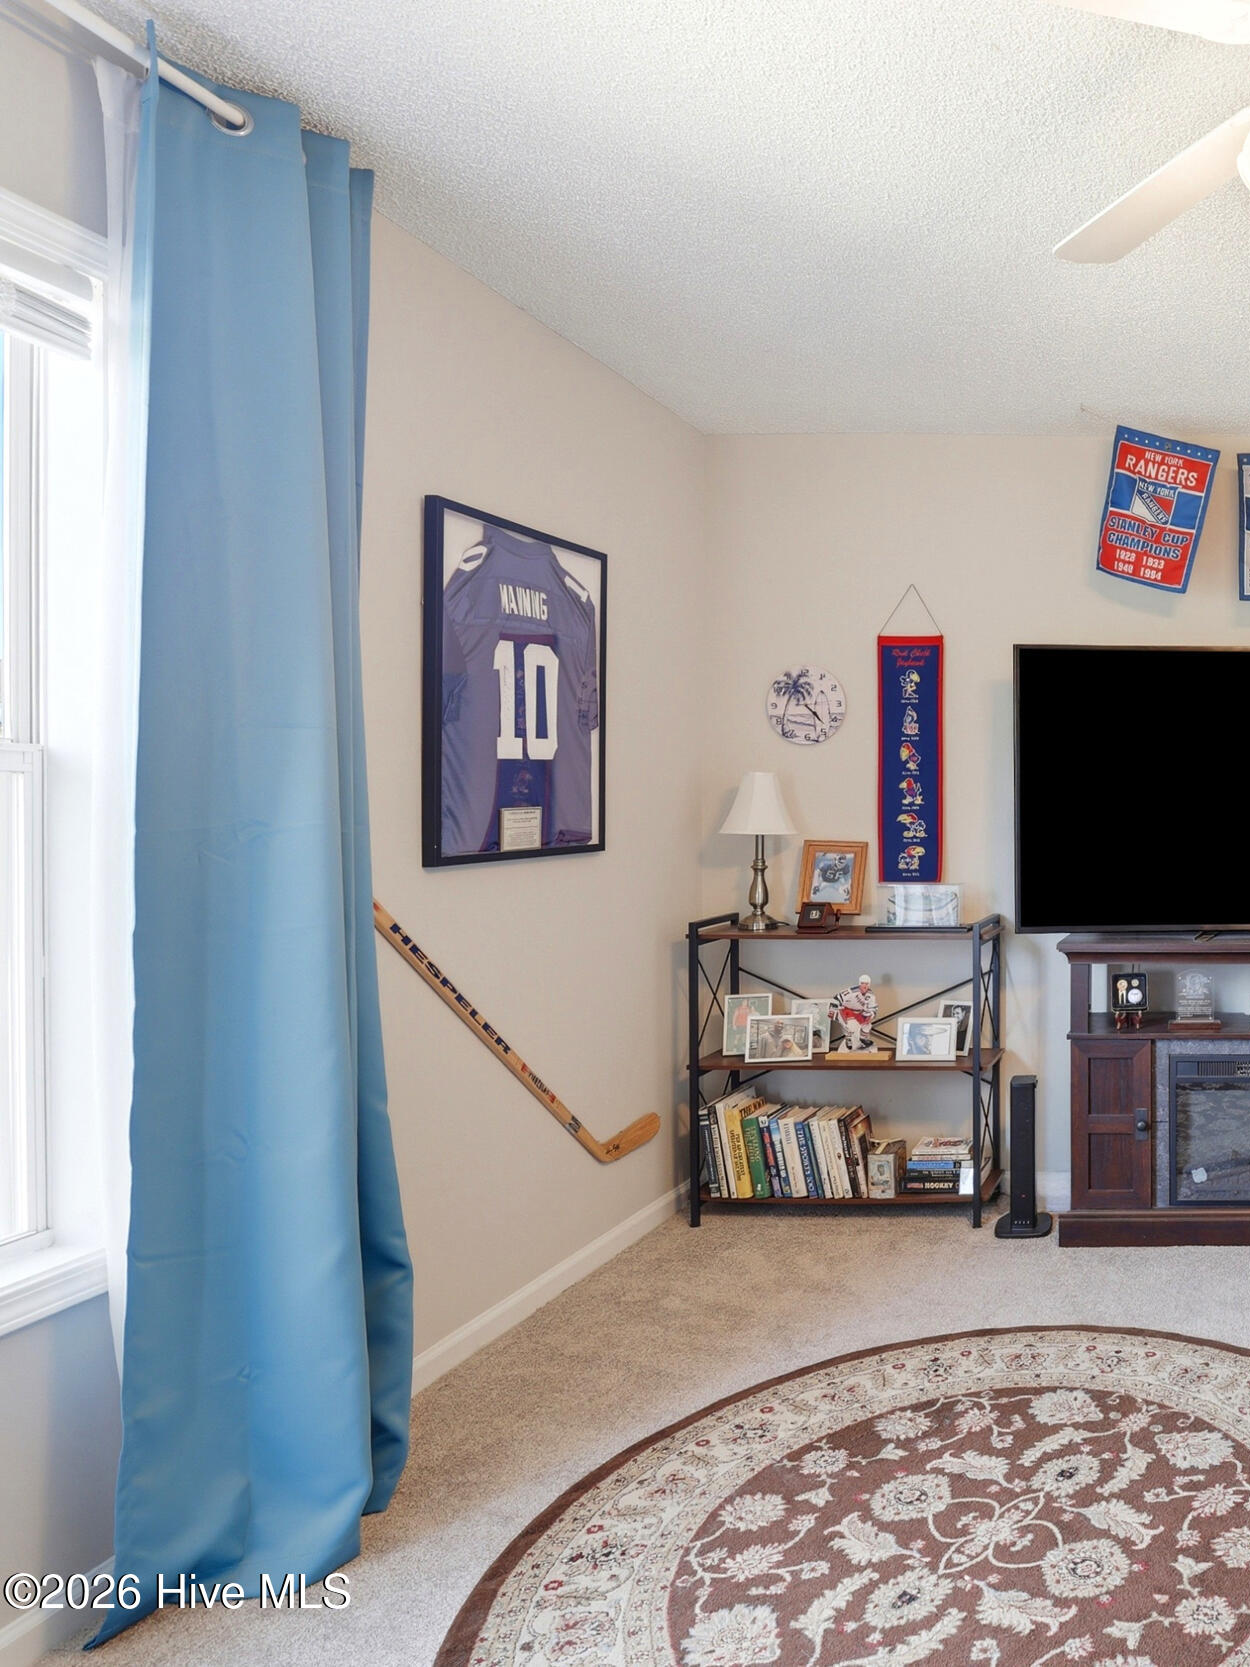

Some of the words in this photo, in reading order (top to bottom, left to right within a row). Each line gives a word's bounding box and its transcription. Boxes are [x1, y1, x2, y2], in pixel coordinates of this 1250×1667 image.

[1125, 454, 1198, 486] RANGERS
[1145, 451, 1162, 462] NEW
[1164, 454, 1184, 467] YORK
[1138, 481, 1156, 492] NEW
[1157, 488, 1176, 498] YORK
[1107, 532, 1181, 560] CHAMPIONS
[1108, 515, 1158, 539] STANLEY
[1162, 532, 1189, 546] CUP
[498, 584, 548, 621] MANNING
[493, 640, 559, 760] 10
[390, 923, 512, 1054] HESPELER
[797, 1130, 806, 1146] THE
